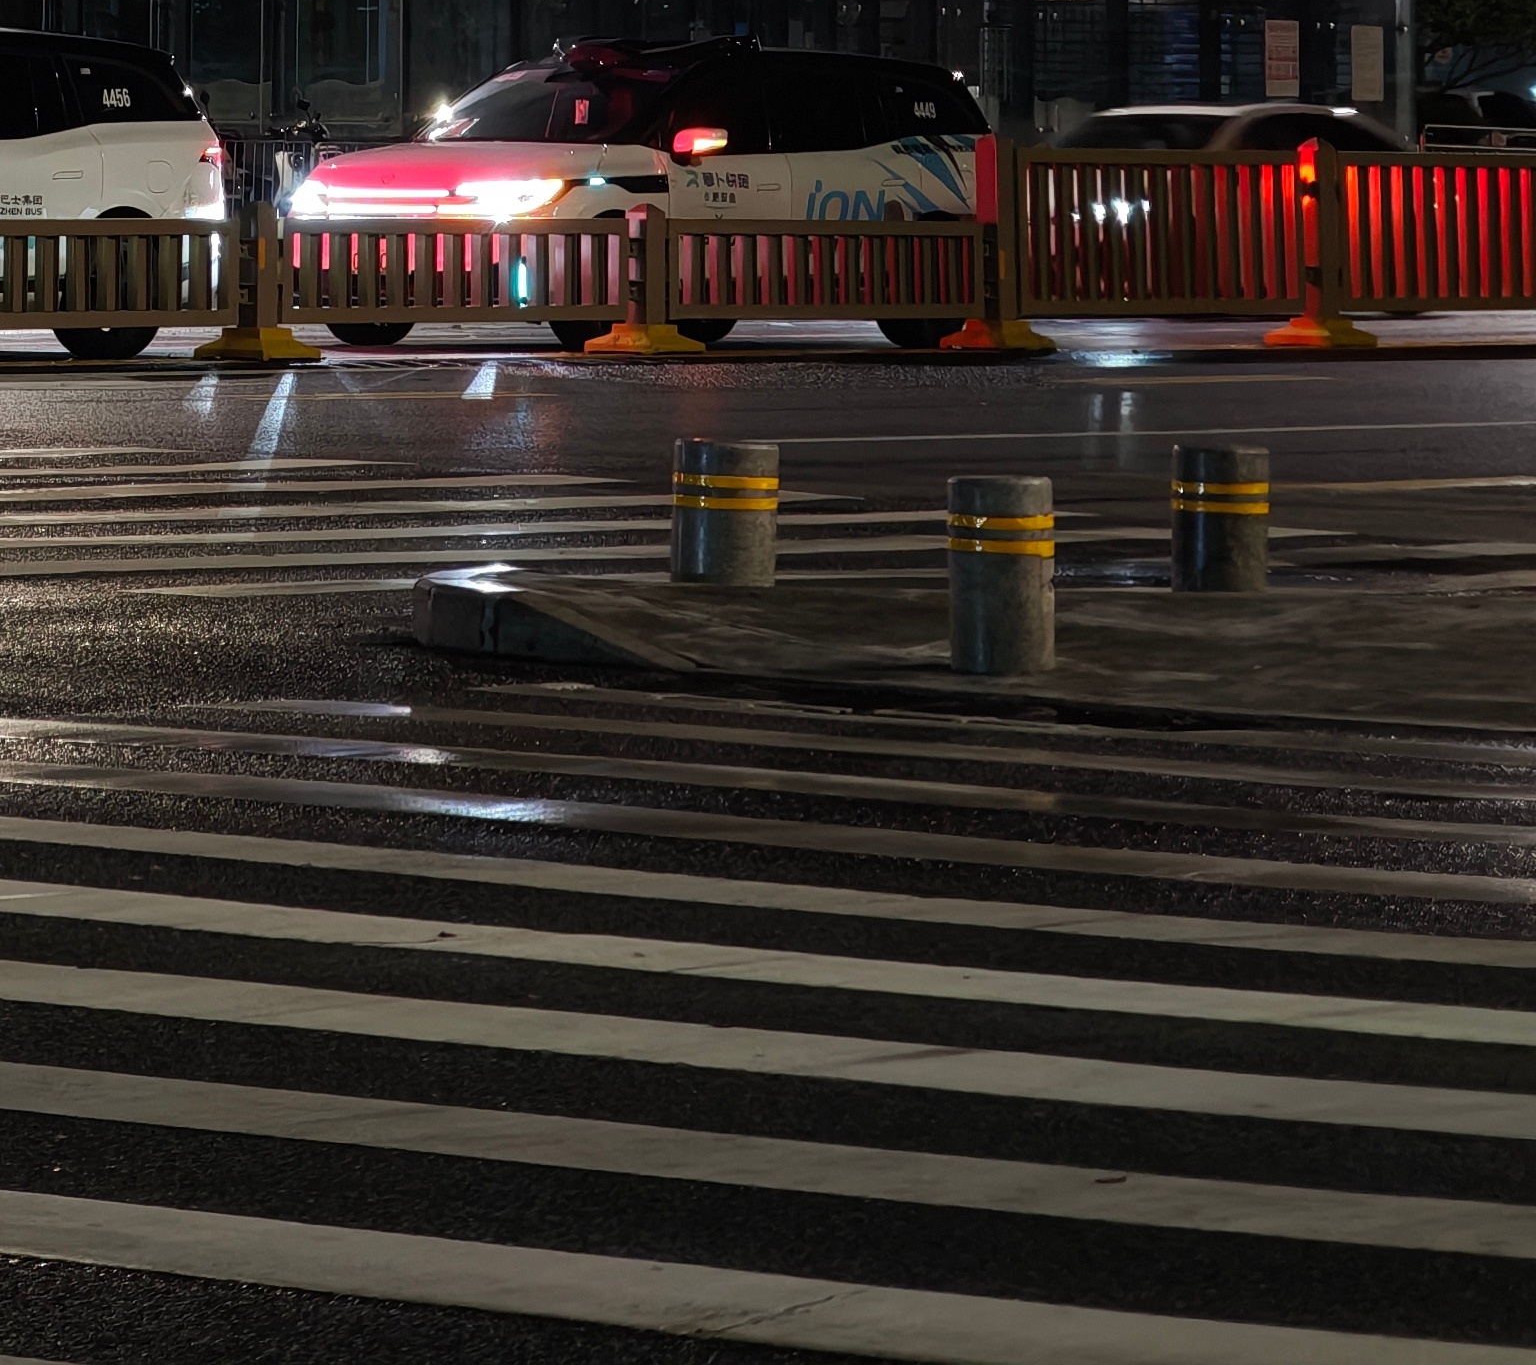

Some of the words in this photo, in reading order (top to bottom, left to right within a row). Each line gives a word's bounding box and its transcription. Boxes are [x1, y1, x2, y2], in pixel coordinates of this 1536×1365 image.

[102, 87, 131, 108] 4456
[913, 100, 937, 119] 4449
[24, 207, 43, 216] BUS
